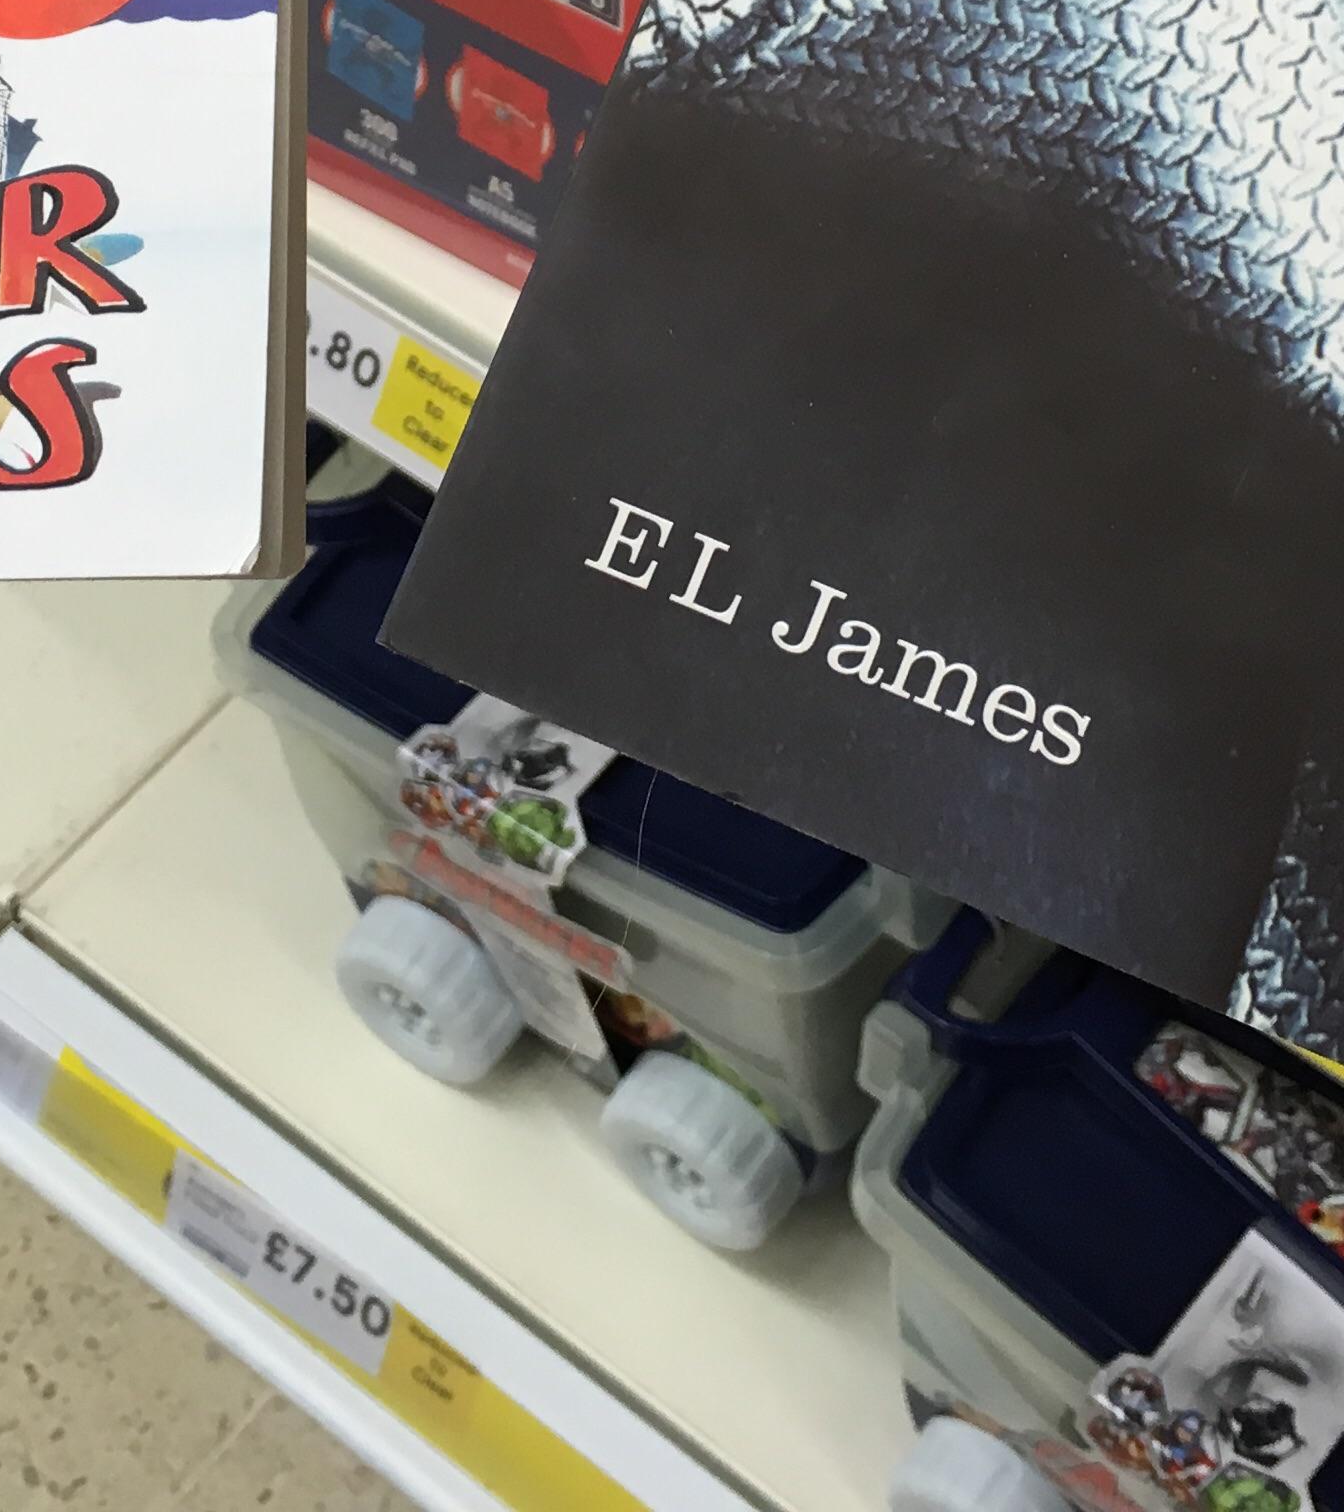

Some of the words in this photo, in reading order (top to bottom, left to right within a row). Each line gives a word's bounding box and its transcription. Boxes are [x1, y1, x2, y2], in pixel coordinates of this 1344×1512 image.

[308, 310, 381, 387] .80
[406, 354, 473, 406] Reduce
[584, 496, 674, 591] E
[668, 531, 743, 626] L
[771, 579, 1093, 768] James
[263, 1231, 391, 1338] £7.50
